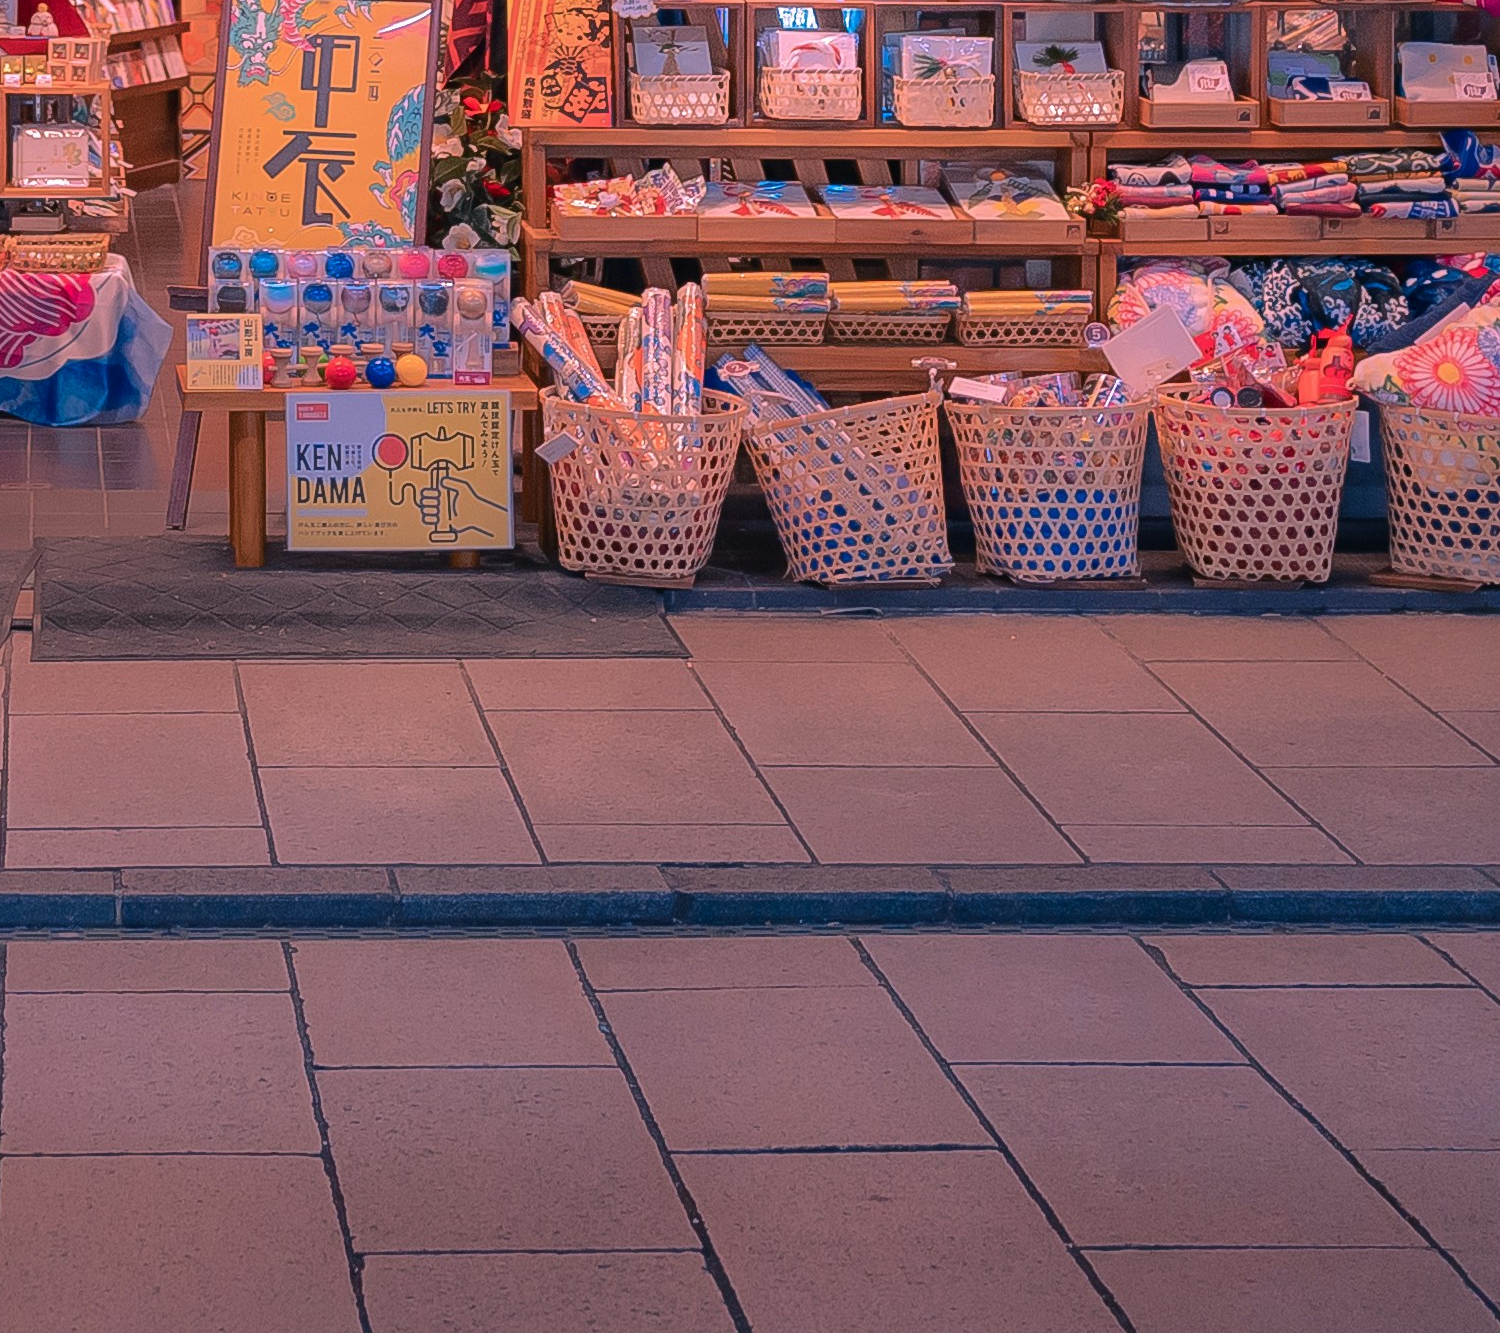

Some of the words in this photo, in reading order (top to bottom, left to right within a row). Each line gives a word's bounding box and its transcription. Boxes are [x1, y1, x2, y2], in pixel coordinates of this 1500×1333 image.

[262, 34, 361, 226] 甲辰
[427, 402, 454, 414] LET'S
[456, 402, 477, 414] TRY
[296, 443, 342, 472] KEN
[296, 476, 367, 504] DAMA
